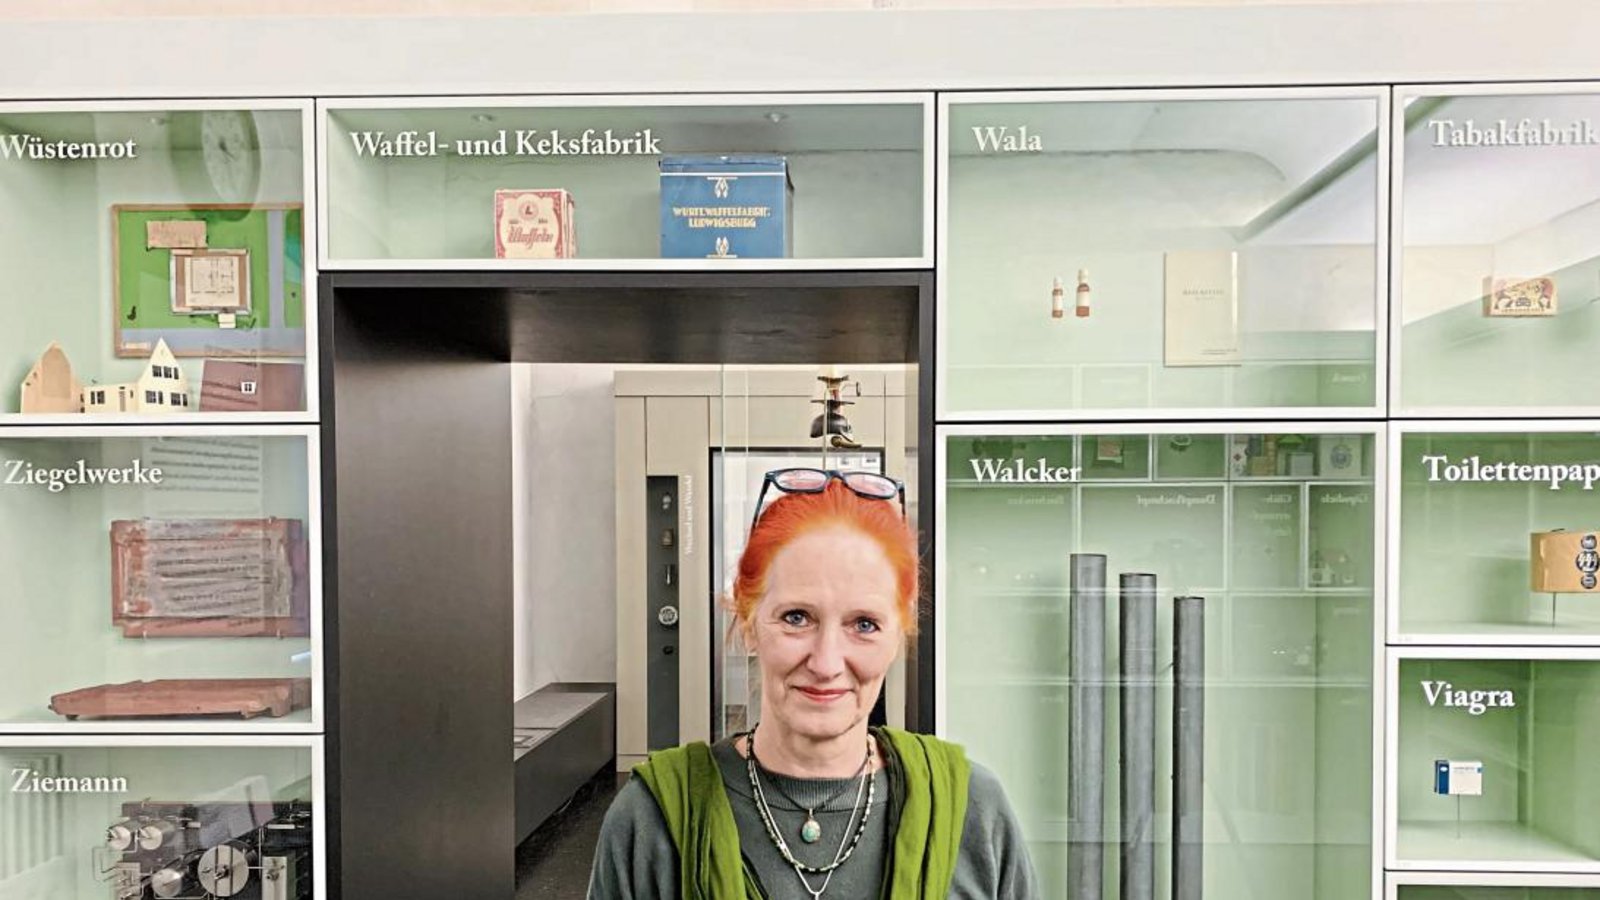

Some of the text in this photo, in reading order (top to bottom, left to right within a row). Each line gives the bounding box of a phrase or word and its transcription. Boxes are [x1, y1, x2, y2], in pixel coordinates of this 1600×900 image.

[0, 134, 137, 160] Wüstenrot
[350, 128, 662, 157] Waffel- und Keksfabrik
[971, 125, 1043, 152] Wala
[1428, 118, 1600, 147] Tabakfabrik
[3, 459, 163, 493] Ziegelwerke
[968, 457, 1082, 482] Walcker
[1421, 455, 1600, 490] Toilettenpap
[1420, 680, 1515, 715] Viagra
[10, 768, 128, 793] Ziemann
